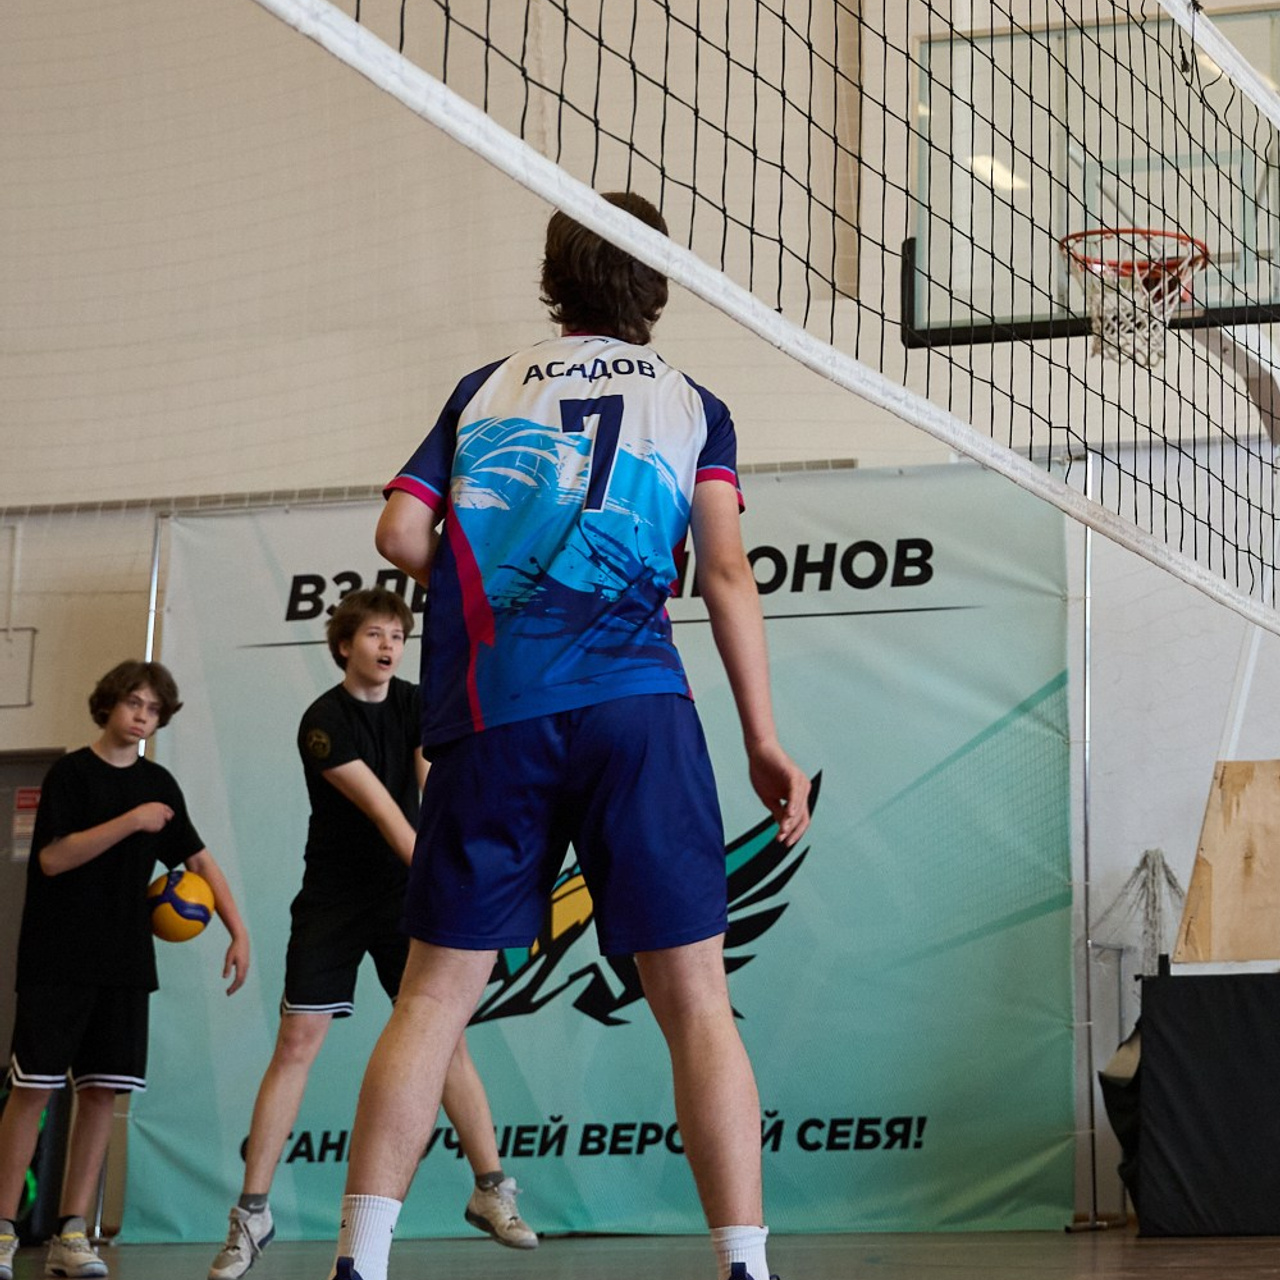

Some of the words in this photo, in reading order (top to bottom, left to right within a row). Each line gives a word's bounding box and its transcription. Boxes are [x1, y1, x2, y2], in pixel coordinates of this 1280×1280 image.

[522, 358, 656, 386] АСАДОВ
[559, 394, 625, 510] 7
[796, 1116, 928, 1153] СЕБЯ!
